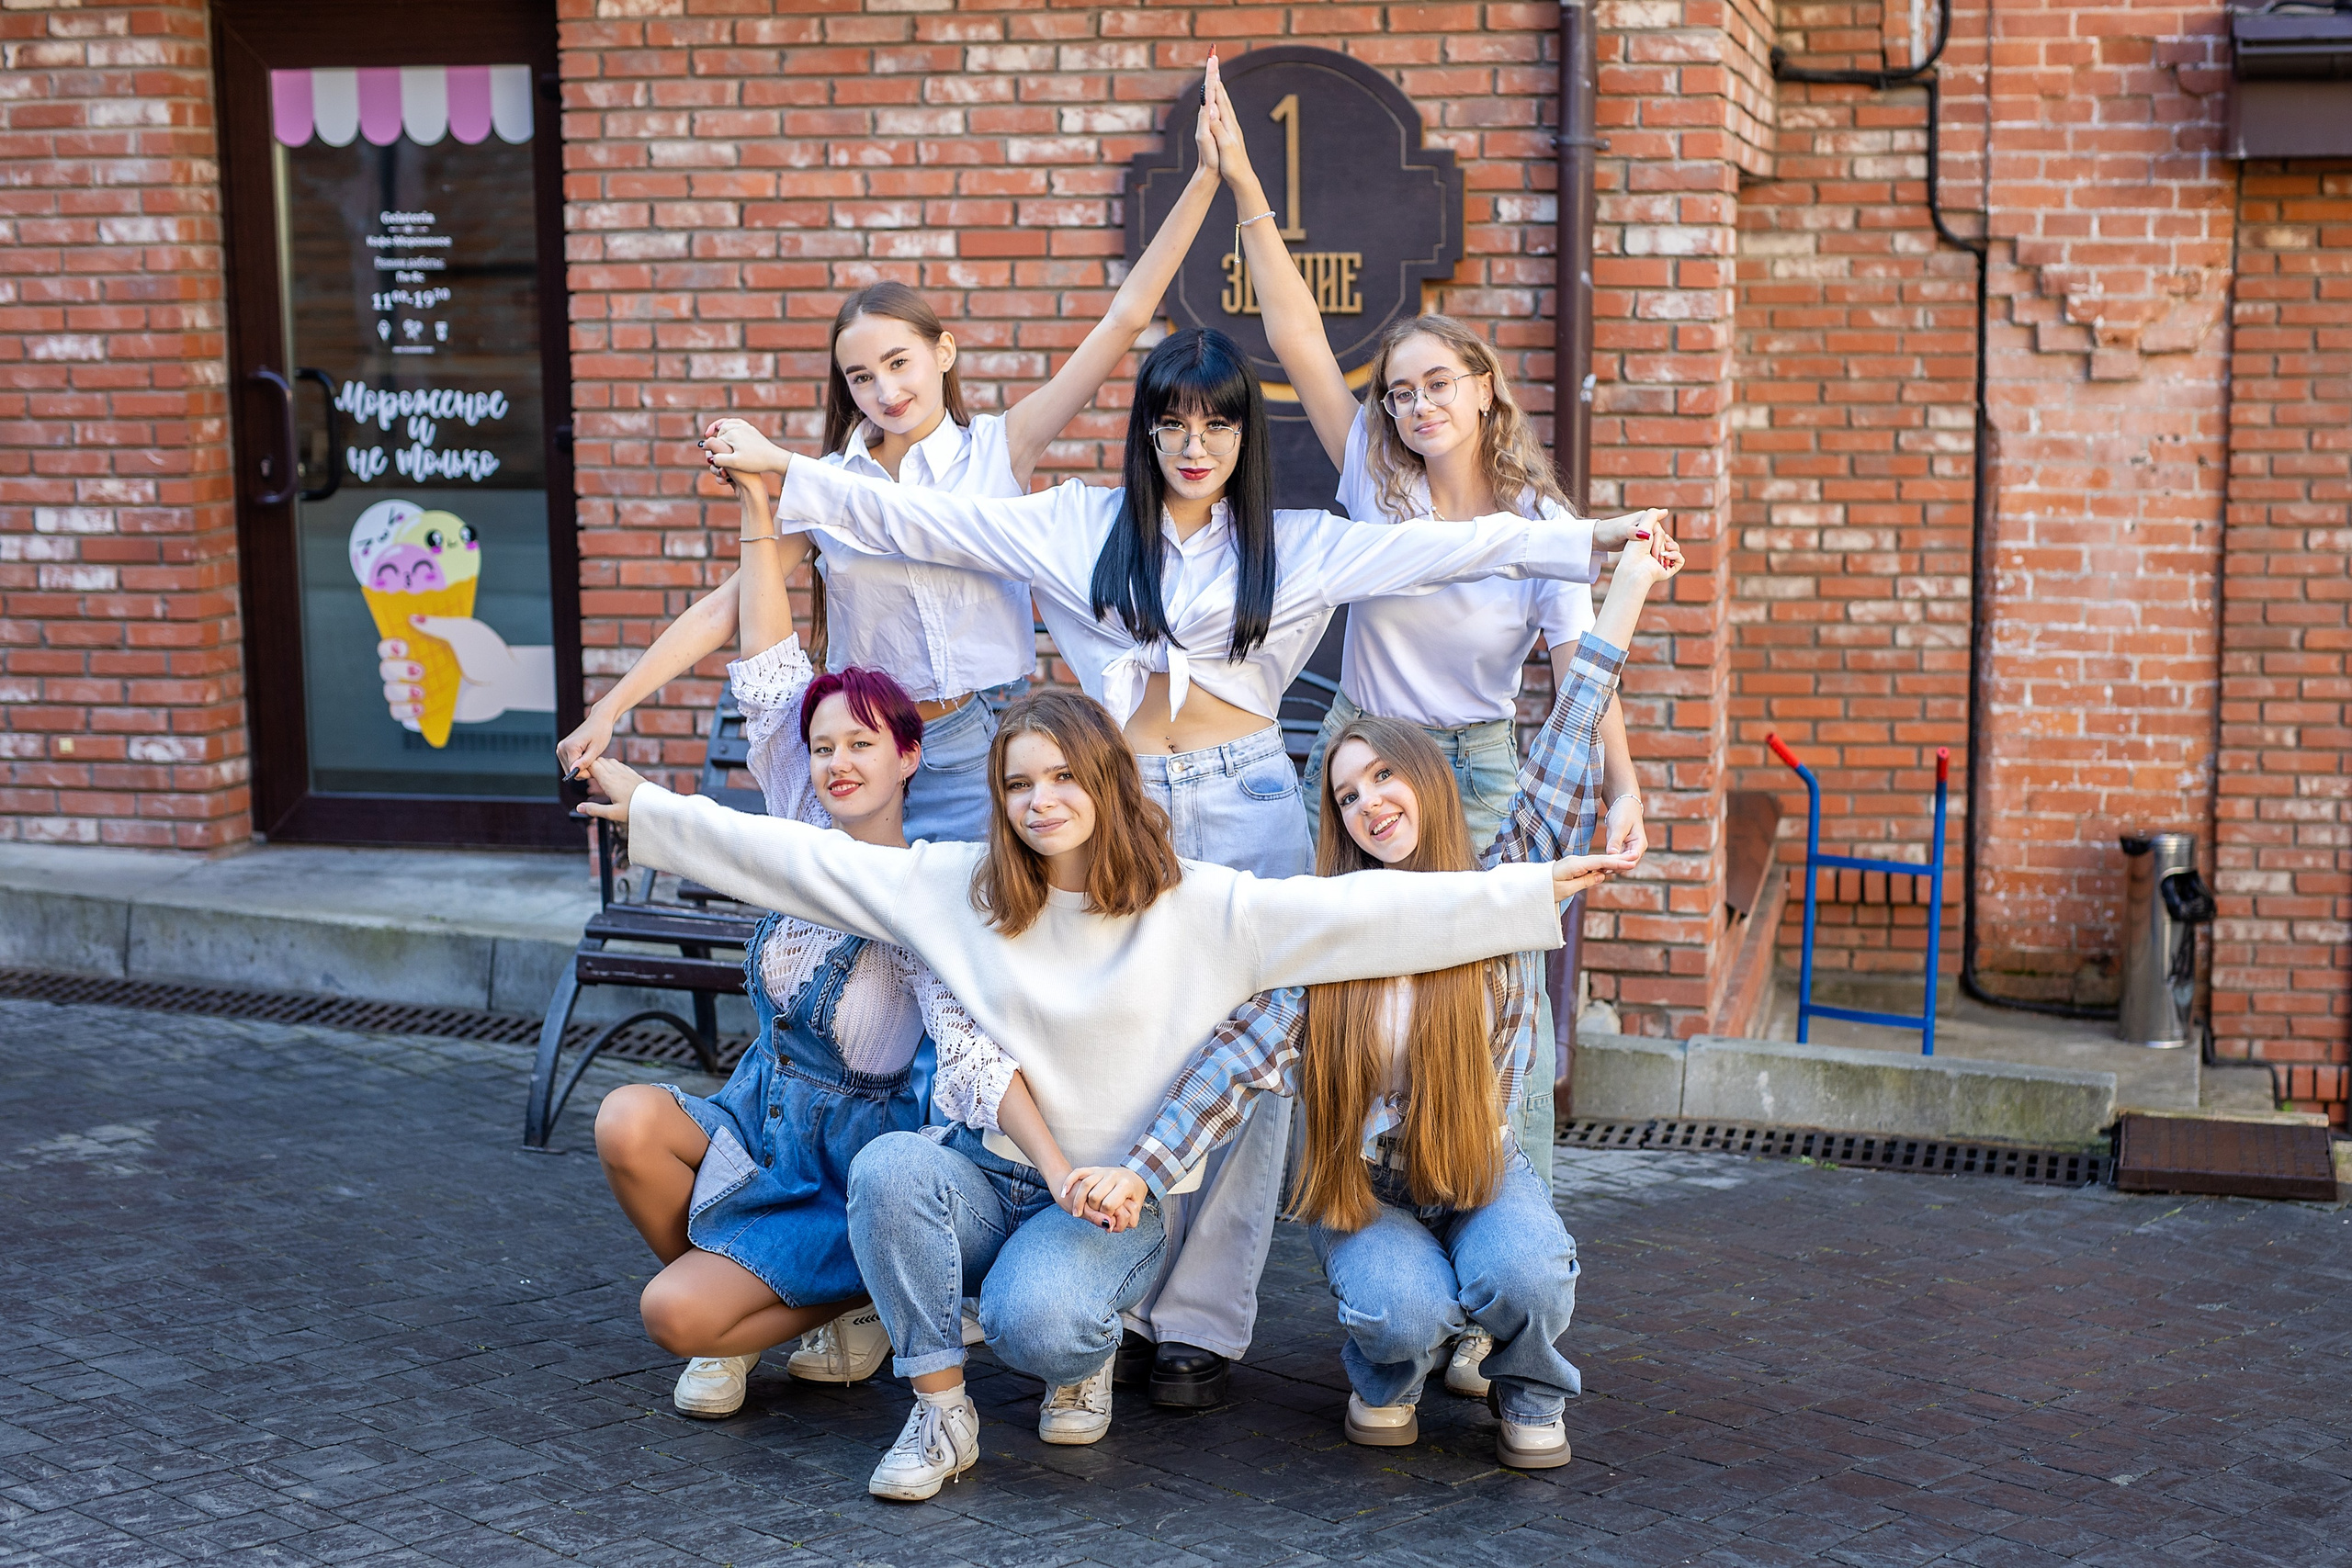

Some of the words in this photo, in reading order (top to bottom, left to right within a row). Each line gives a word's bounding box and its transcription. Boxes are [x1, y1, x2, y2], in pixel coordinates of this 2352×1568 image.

[1269, 93, 1307, 241] 1
[1221, 252, 1363, 314] ЗИЕ
[334, 379, 509, 432] Мороженое
[346, 446, 389, 483] не
[395, 441, 501, 483] только
